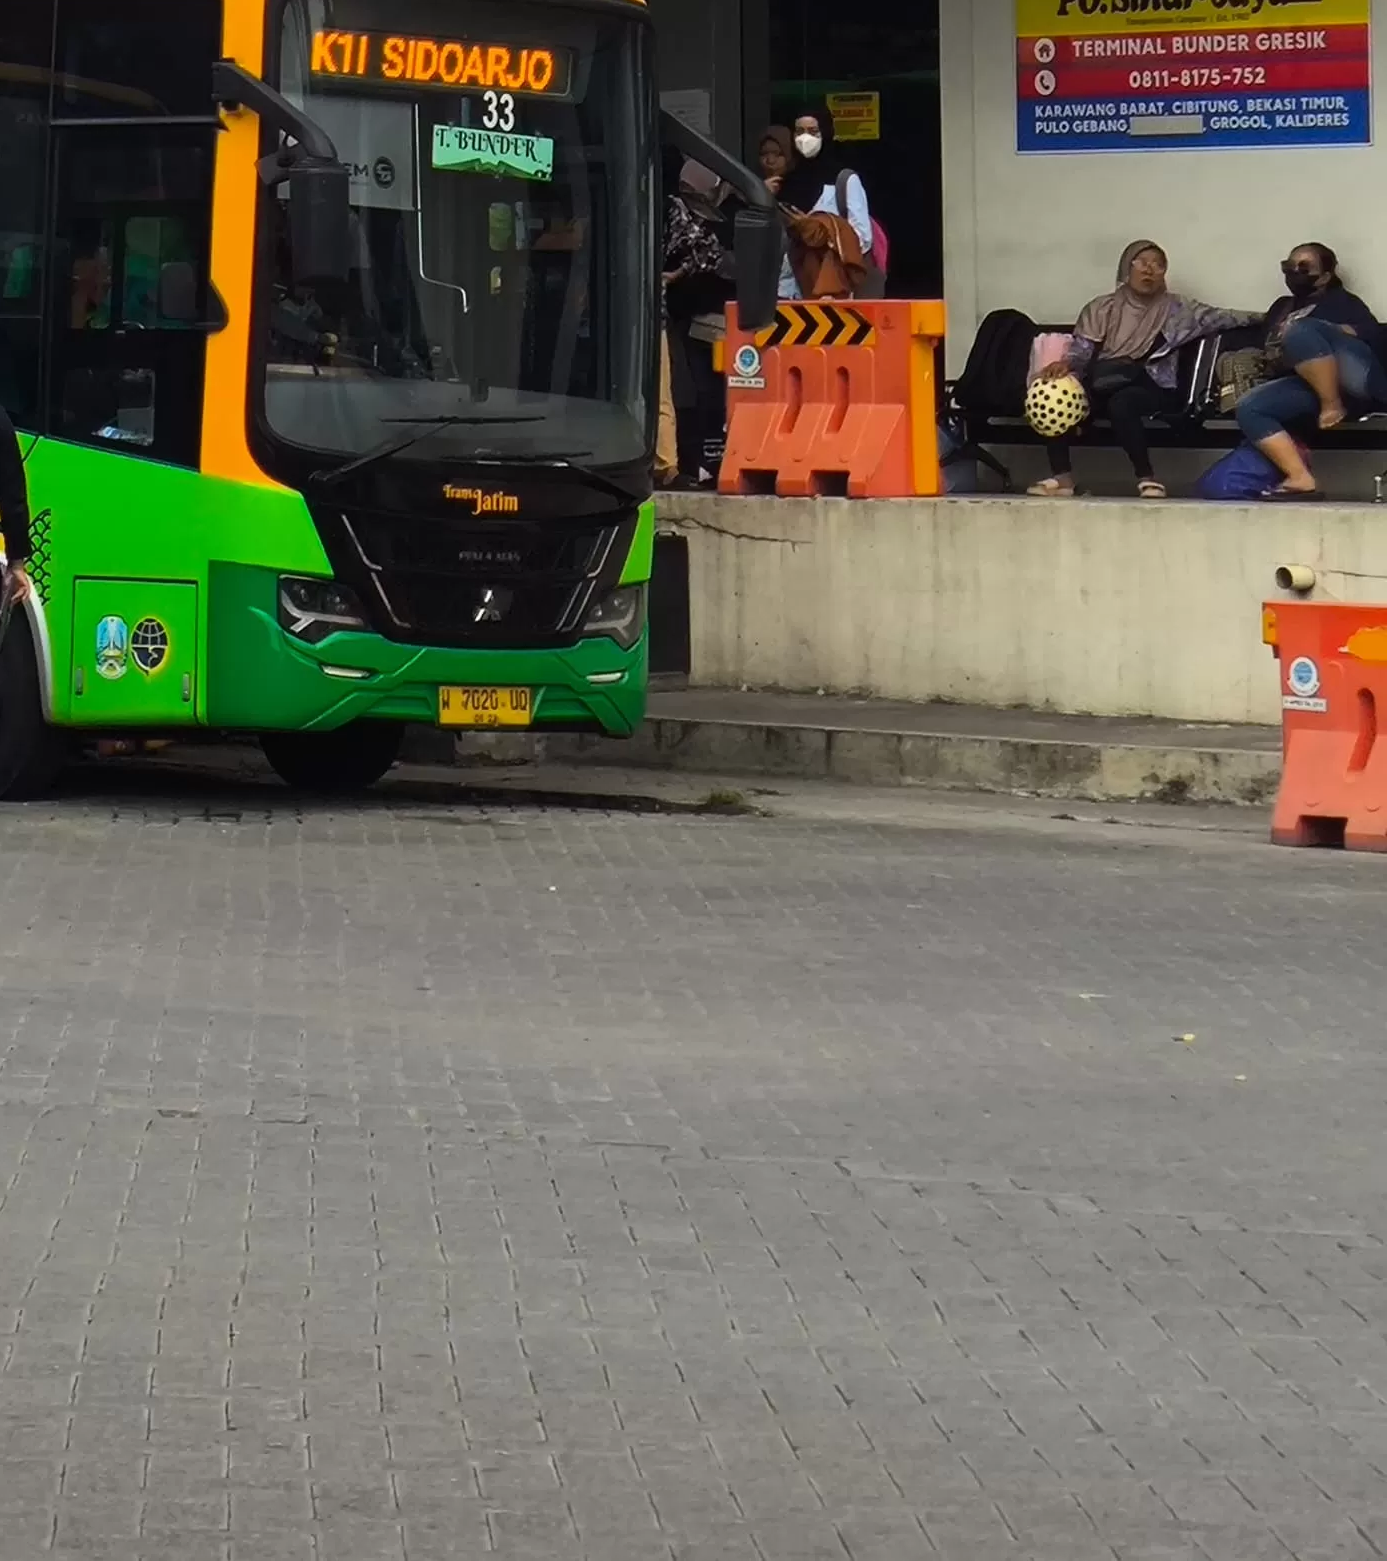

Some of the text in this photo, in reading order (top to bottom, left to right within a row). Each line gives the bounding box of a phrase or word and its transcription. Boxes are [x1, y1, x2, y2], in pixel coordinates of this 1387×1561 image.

[1073, 30, 1327, 58] TERMINAL BUNDER GRESIK
[382, 38, 554, 90] SIDOARJO
[1129, 67, 1266, 88] 0811-8175-752
[482, 90, 515, 131] 33
[1035, 96, 1349, 118] KARAWANG BARAT, CIBITUNG, BEKASI TIMUR,
[1035, 111, 1350, 135] PULO GEBANG, GROGOL, KALIDERES
[435, 128, 450, 149] T.
[443, 484, 518, 516] Trans Jatim
[461, 689, 499, 711] 7020
